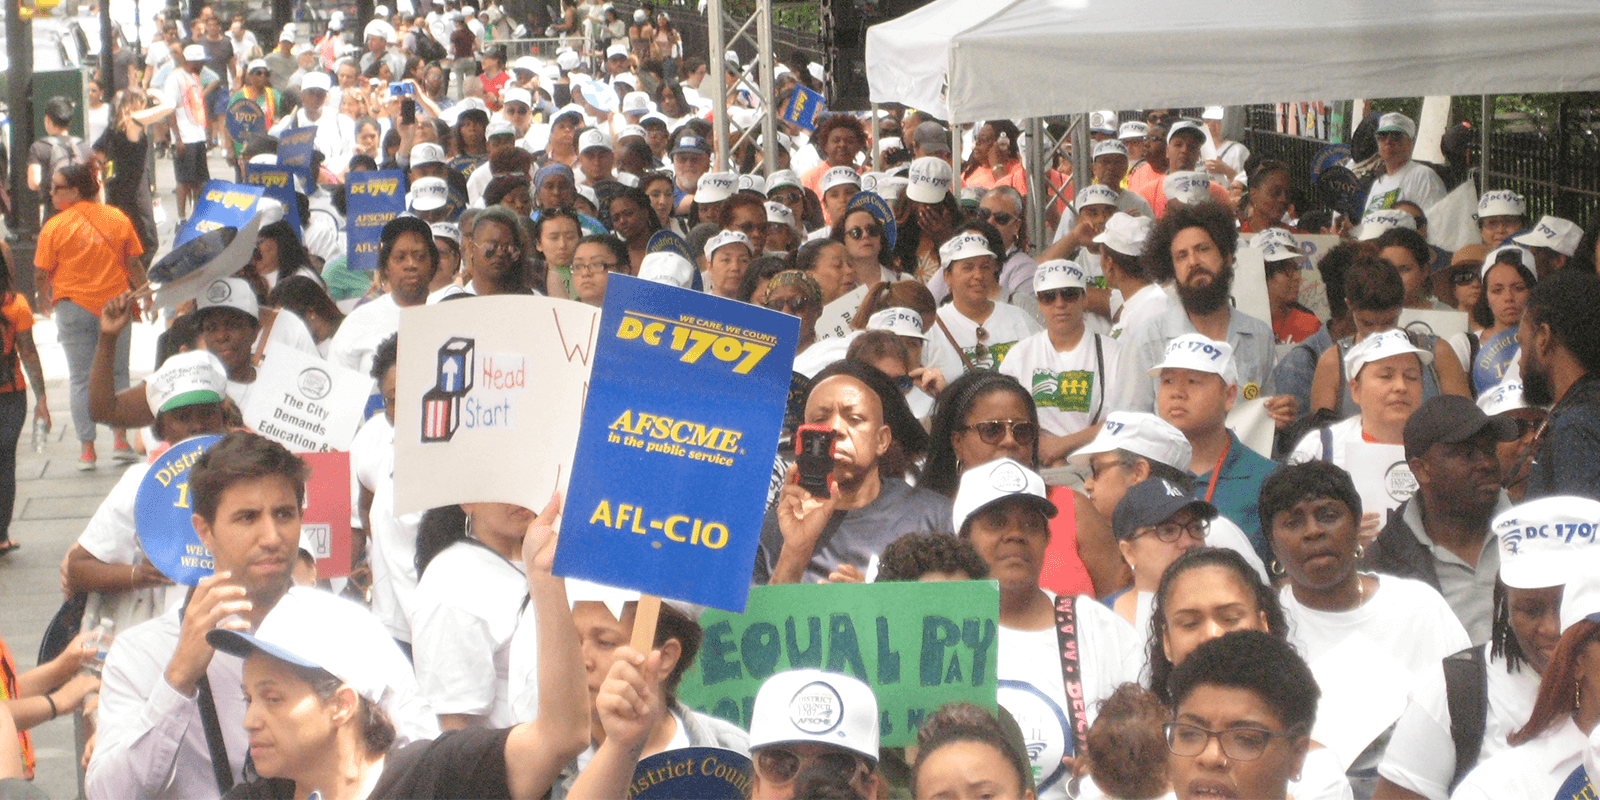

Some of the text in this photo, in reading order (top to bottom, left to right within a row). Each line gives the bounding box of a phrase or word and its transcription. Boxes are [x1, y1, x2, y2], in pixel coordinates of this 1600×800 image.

[351, 178, 398, 196] DC 1707
[429, 186, 445, 194] 1707
[713, 178, 733, 189] 1707
[921, 176, 930, 184] DC
[1062, 265, 1083, 280] 1707
[680, 315, 779, 345] WE CARE. WE COUNT.
[616, 316, 772, 375] DC 1707
[1187, 341, 1223, 361] 1707
[482, 356, 526, 391] Head
[273, 407, 327, 437] Demands
[283, 393, 330, 421] The City
[465, 397, 511, 429] Start
[257, 420, 329, 453] Education &
[608, 409, 743, 454] AFSCME
[608, 432, 734, 467] in the public service
[589, 500, 730, 549] AFL-CIO
[1525, 523, 1599, 544] DC 1707
[181, 556, 199, 567] WE
[186, 544, 203, 555] WE
[702, 613, 900, 686] EQUAL
[919, 615, 996, 687] PAY
[627, 759, 694, 800] istrict
